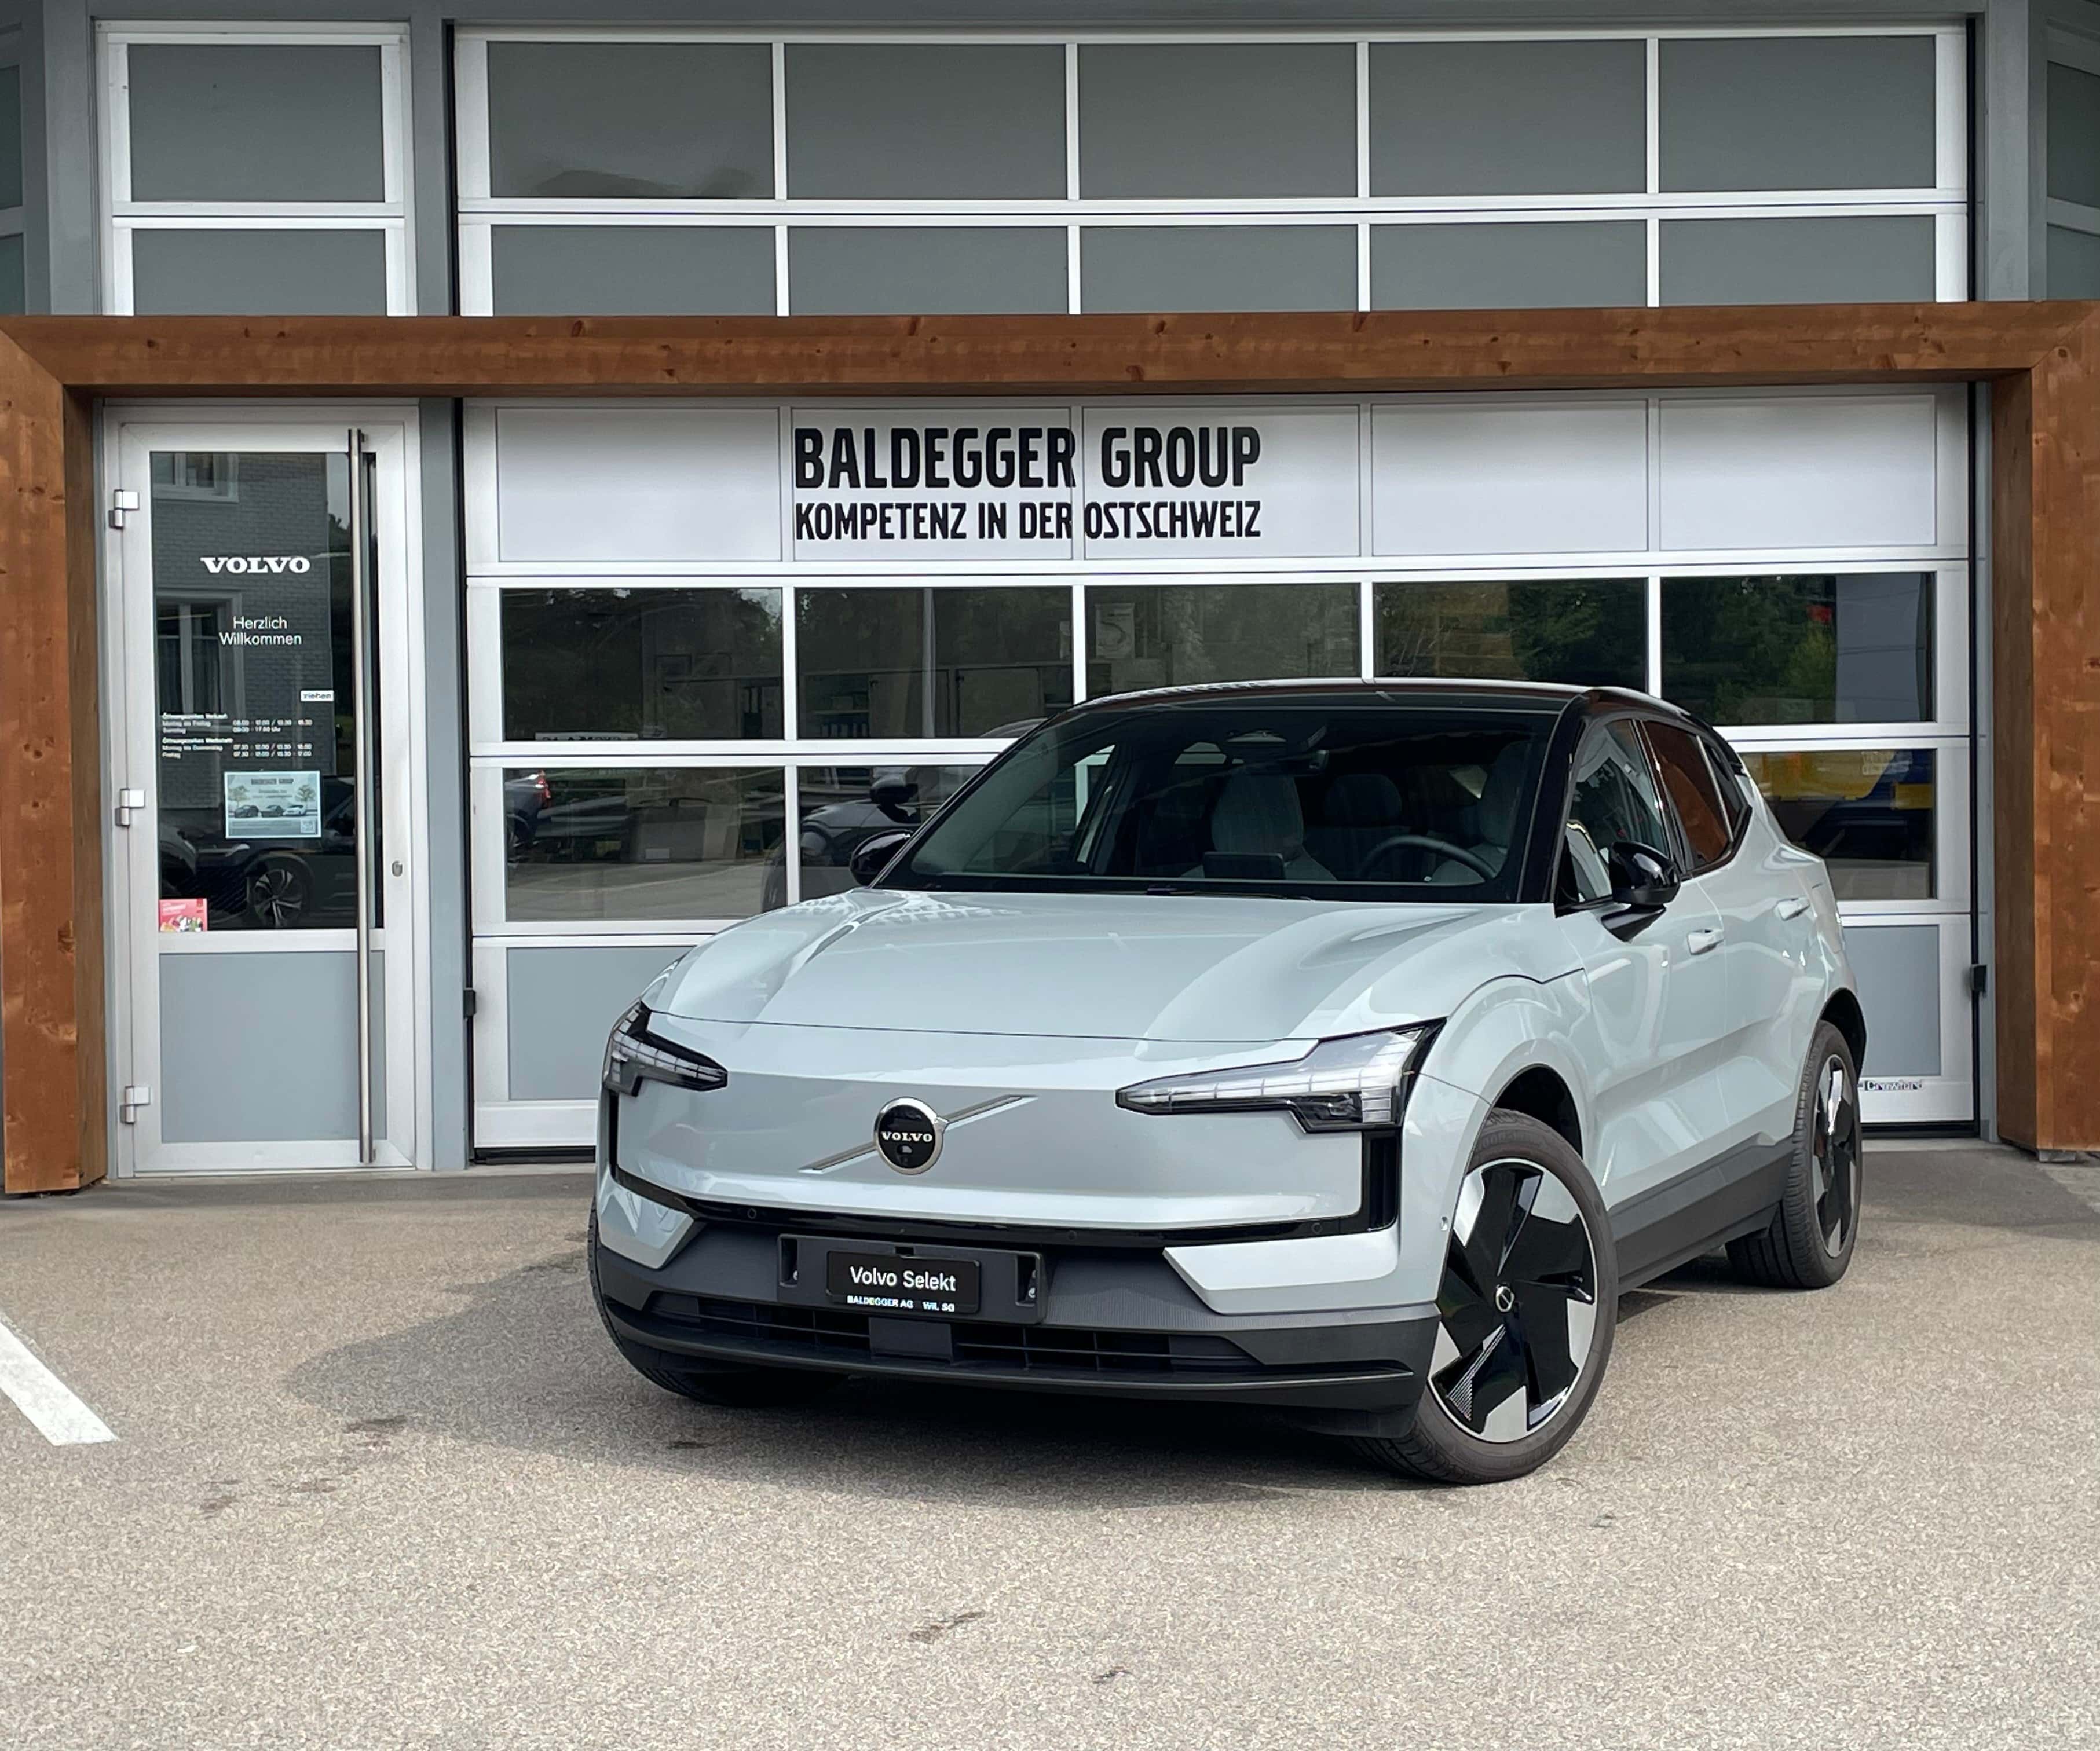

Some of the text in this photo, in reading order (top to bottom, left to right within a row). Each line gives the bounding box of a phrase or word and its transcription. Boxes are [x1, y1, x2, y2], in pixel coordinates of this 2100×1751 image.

[794, 426, 1260, 489] BALDEGGER GROUP
[795, 500, 1261, 540] KOMPETENZ IN DER OSTSCHWEIZ
[200, 556, 310, 574] VOLVO
[233, 616, 287, 629] Herzlich
[218, 632, 302, 646] Willkommen
[881, 1131, 933, 1142] VOLVO
[850, 1266, 957, 1291] Volvo Selekt
[847, 1295, 899, 1307] BALDEGGER
[900, 1300, 914, 1309] AG
[942, 1303, 955, 1312] SG
